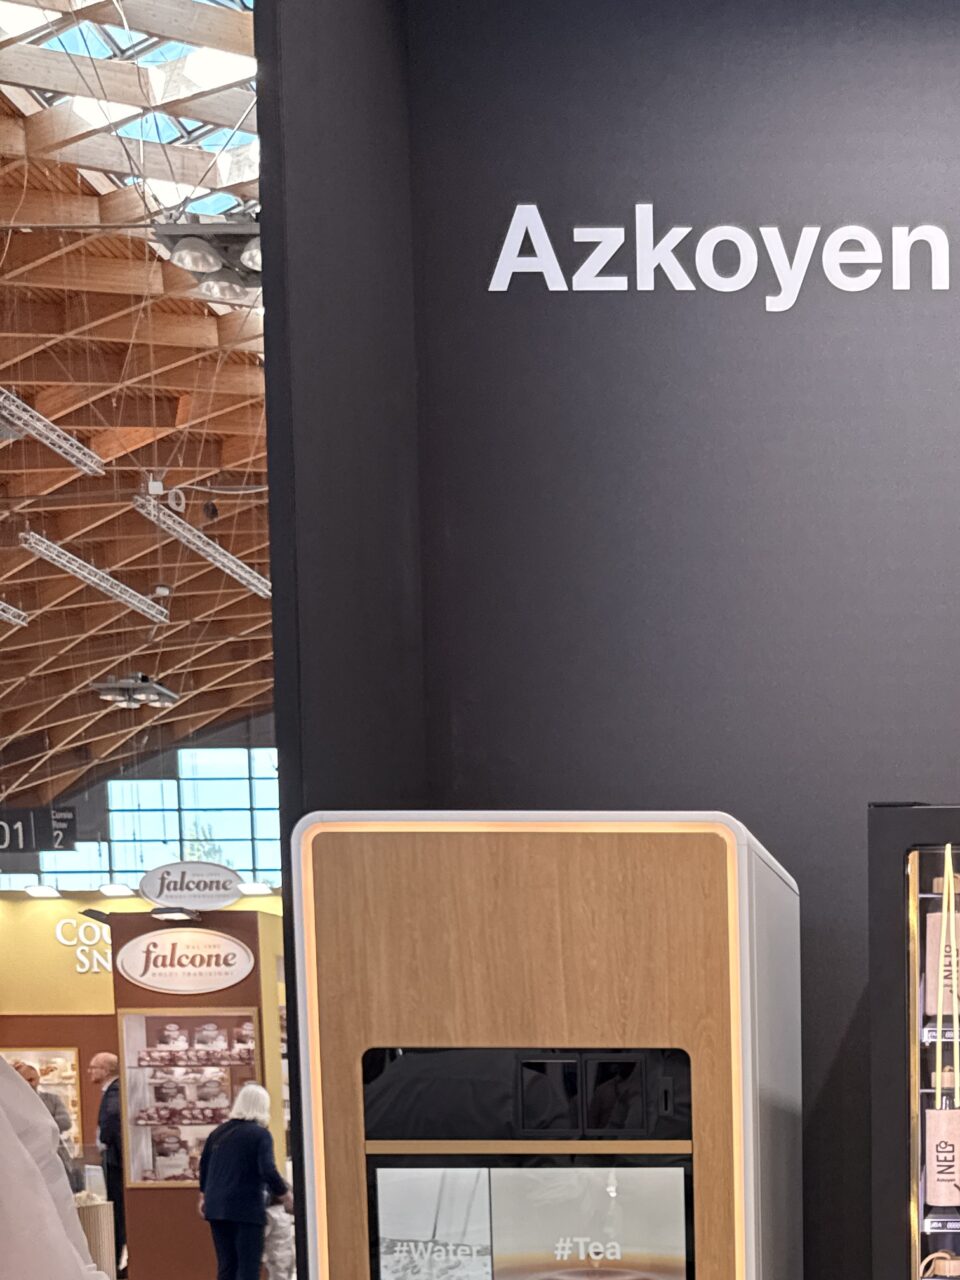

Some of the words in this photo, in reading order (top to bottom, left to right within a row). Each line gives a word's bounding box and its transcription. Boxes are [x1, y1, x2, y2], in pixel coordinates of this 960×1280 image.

[489, 204, 949, 311] Azkoyen
[53, 830, 64, 848] 2
[156, 870, 233, 898] falcone
[139, 942, 237, 978] falcone
[393, 1241, 481, 1262] #Water
[554, 1237, 622, 1261] #Tea
